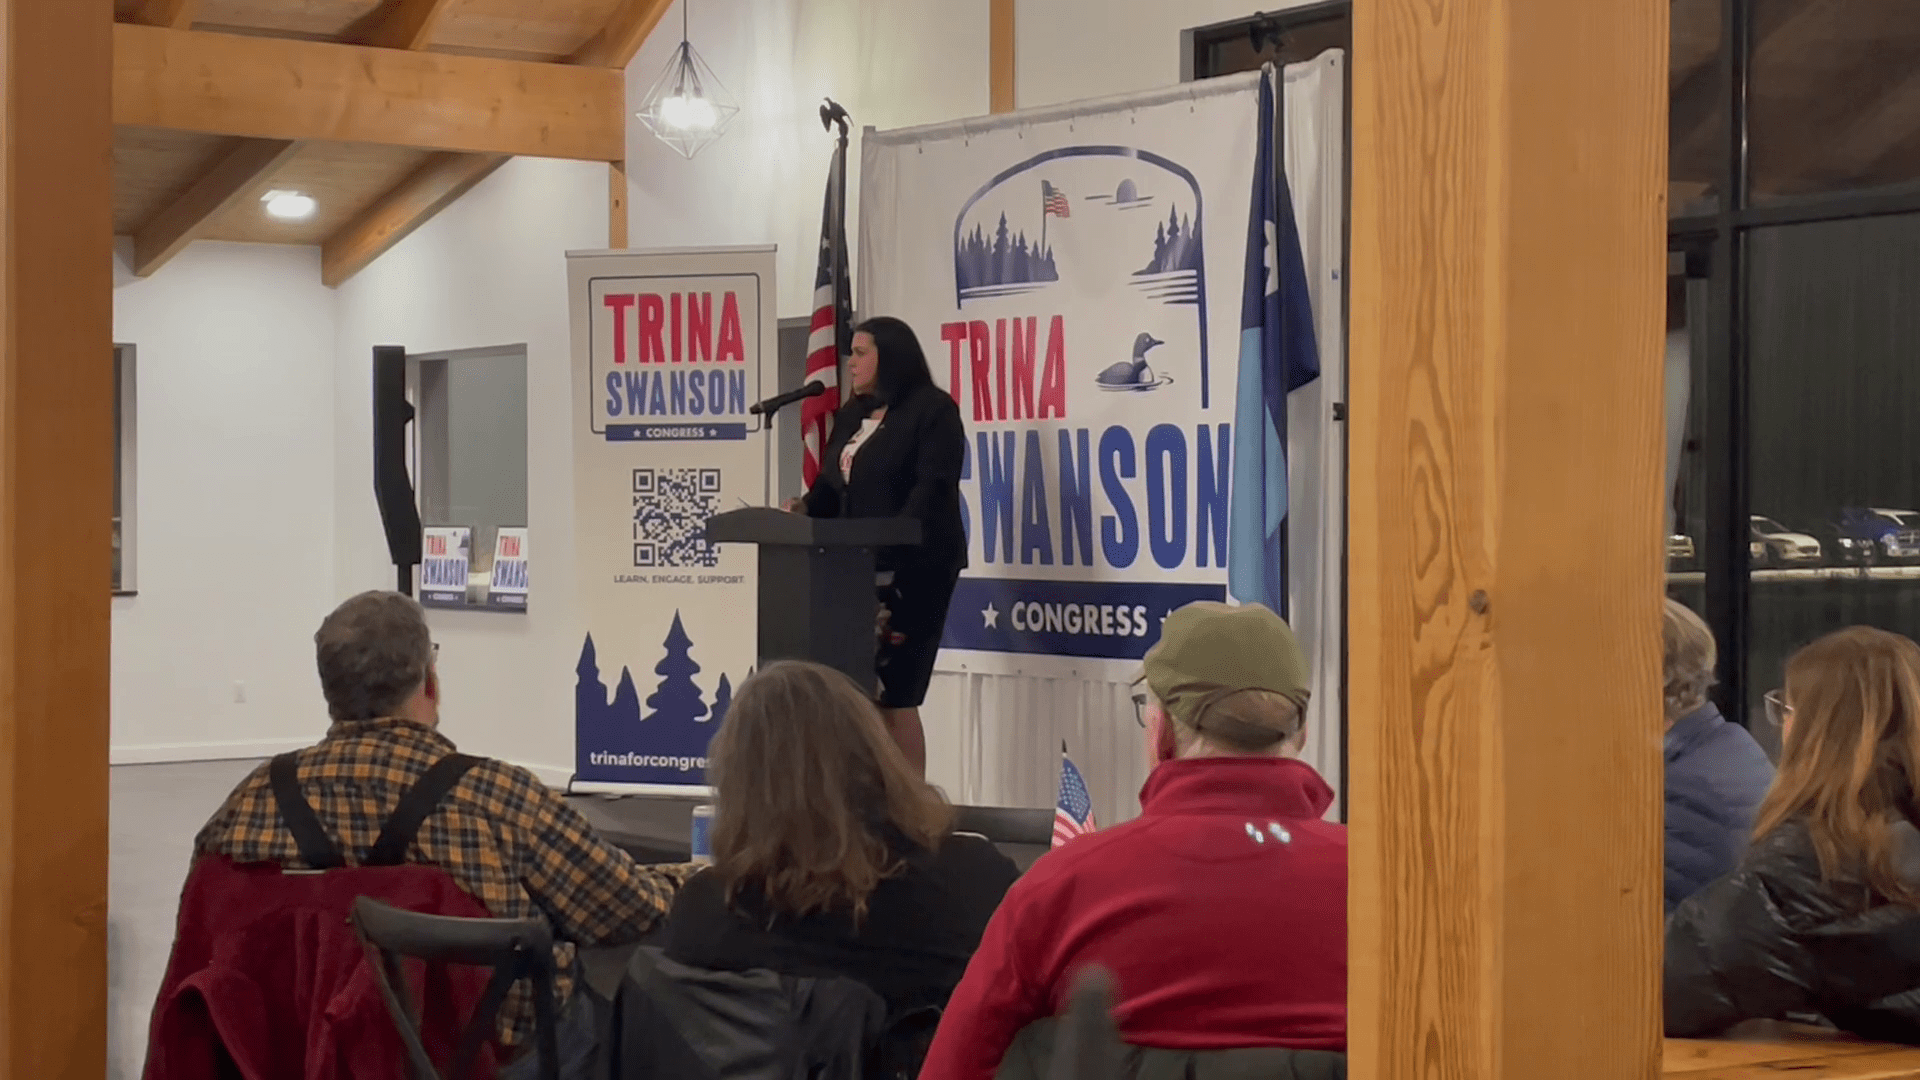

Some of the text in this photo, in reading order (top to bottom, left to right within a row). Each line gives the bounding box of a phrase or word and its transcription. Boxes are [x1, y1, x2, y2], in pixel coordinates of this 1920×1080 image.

[604, 290, 745, 364] TRINA
[941, 314, 1067, 422] TRINA
[606, 369, 746, 417] SWANSON
[645, 427, 705, 441] CONGRESS
[613, 574, 649, 584] LEARN.
[652, 575, 695, 584] ENGAGE.
[1011, 601, 1148, 637] CONGRESS
